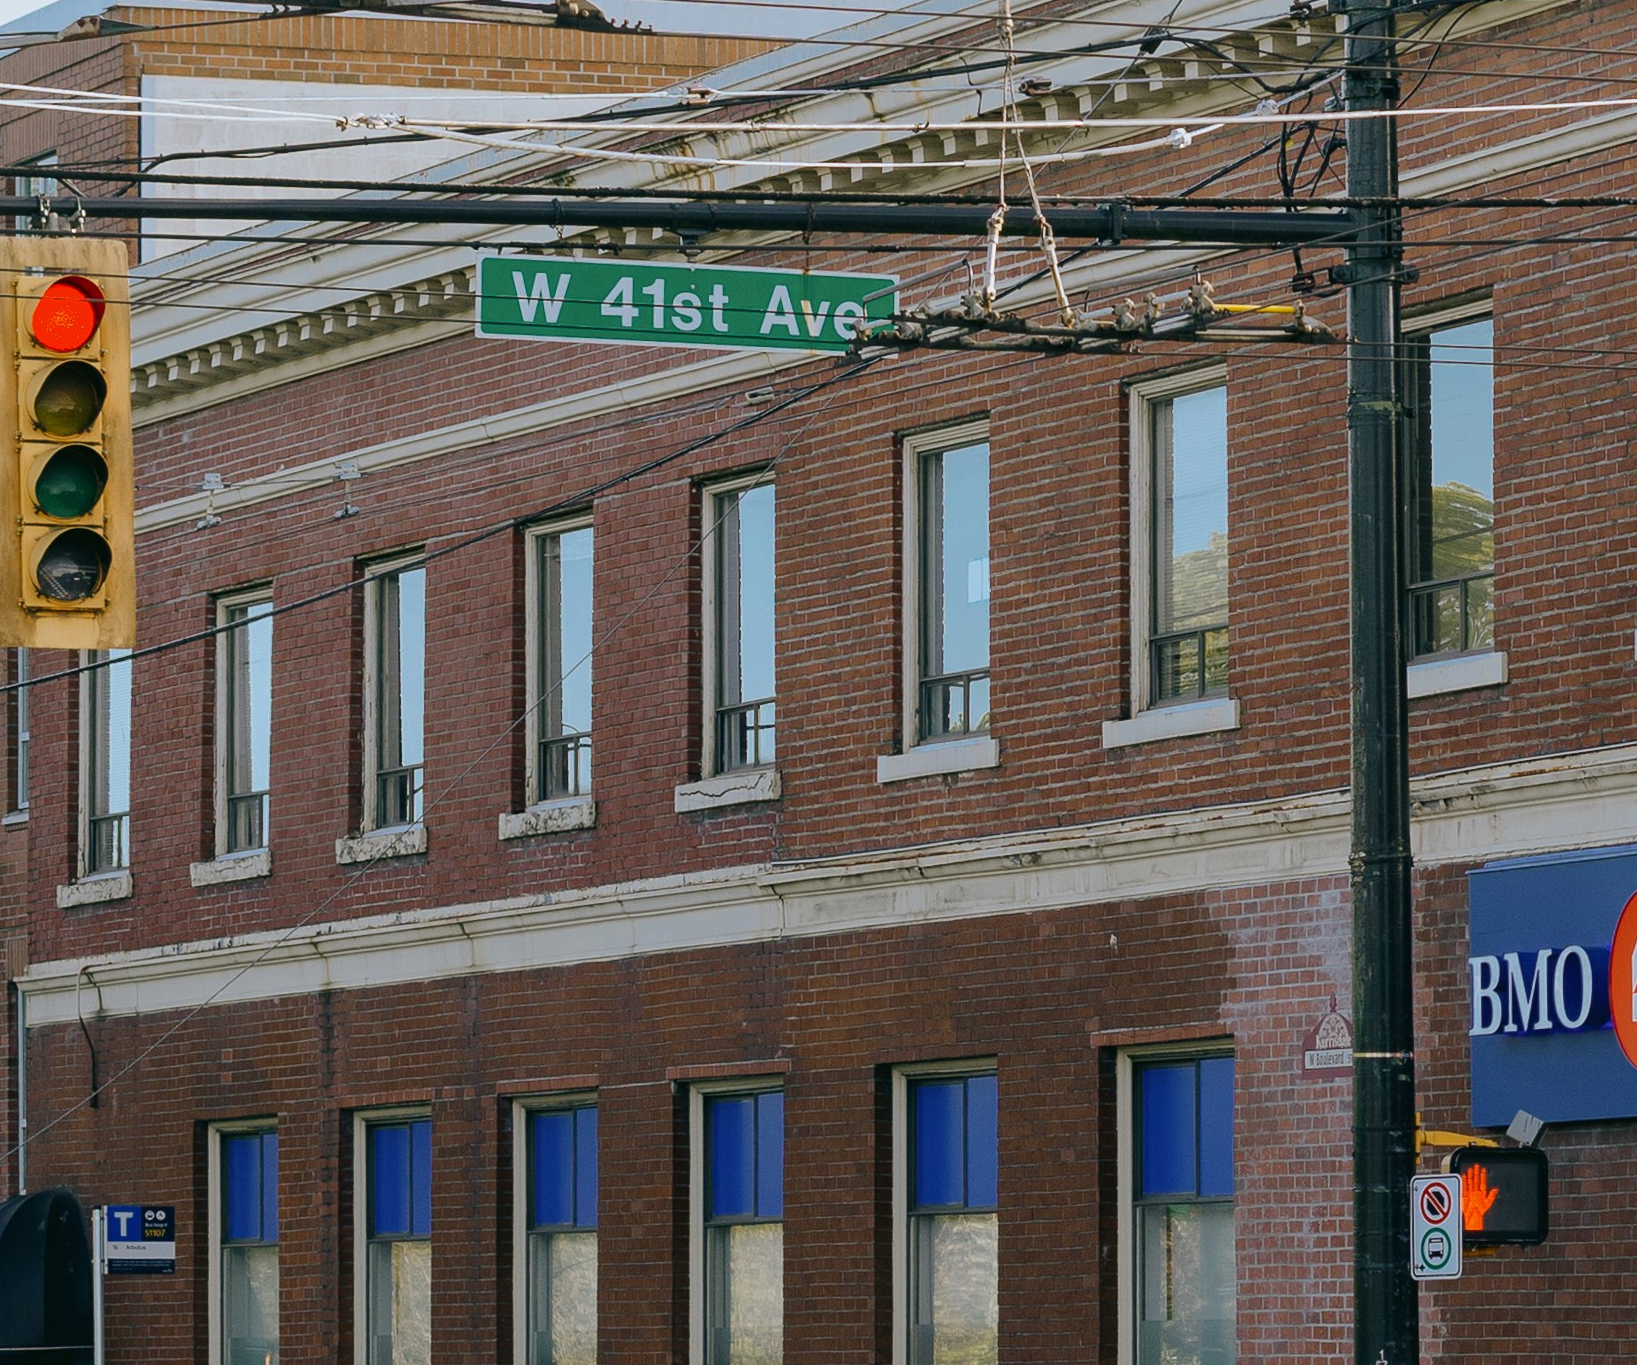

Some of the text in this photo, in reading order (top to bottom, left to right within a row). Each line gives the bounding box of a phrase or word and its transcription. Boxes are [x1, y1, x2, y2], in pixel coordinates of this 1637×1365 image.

[512, 271, 865, 340] W 41st Ave
[1468, 944, 1593, 1036] BMO
